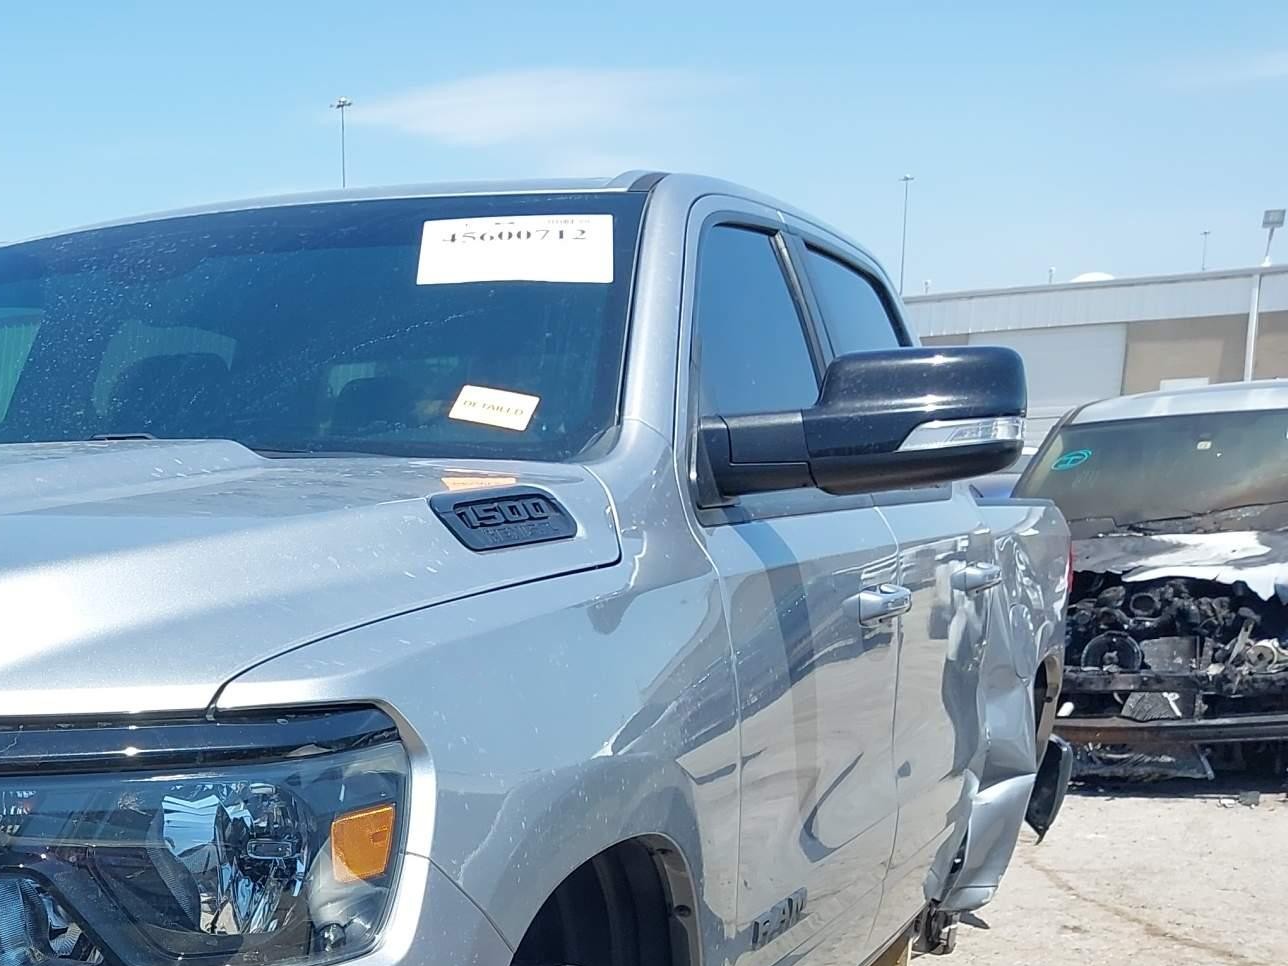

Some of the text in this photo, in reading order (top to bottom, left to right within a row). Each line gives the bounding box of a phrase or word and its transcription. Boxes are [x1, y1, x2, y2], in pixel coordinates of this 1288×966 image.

[442, 230, 588, 243] 45600712
[456, 498, 551, 527] 1500
[752, 887, 807, 951] RAM
